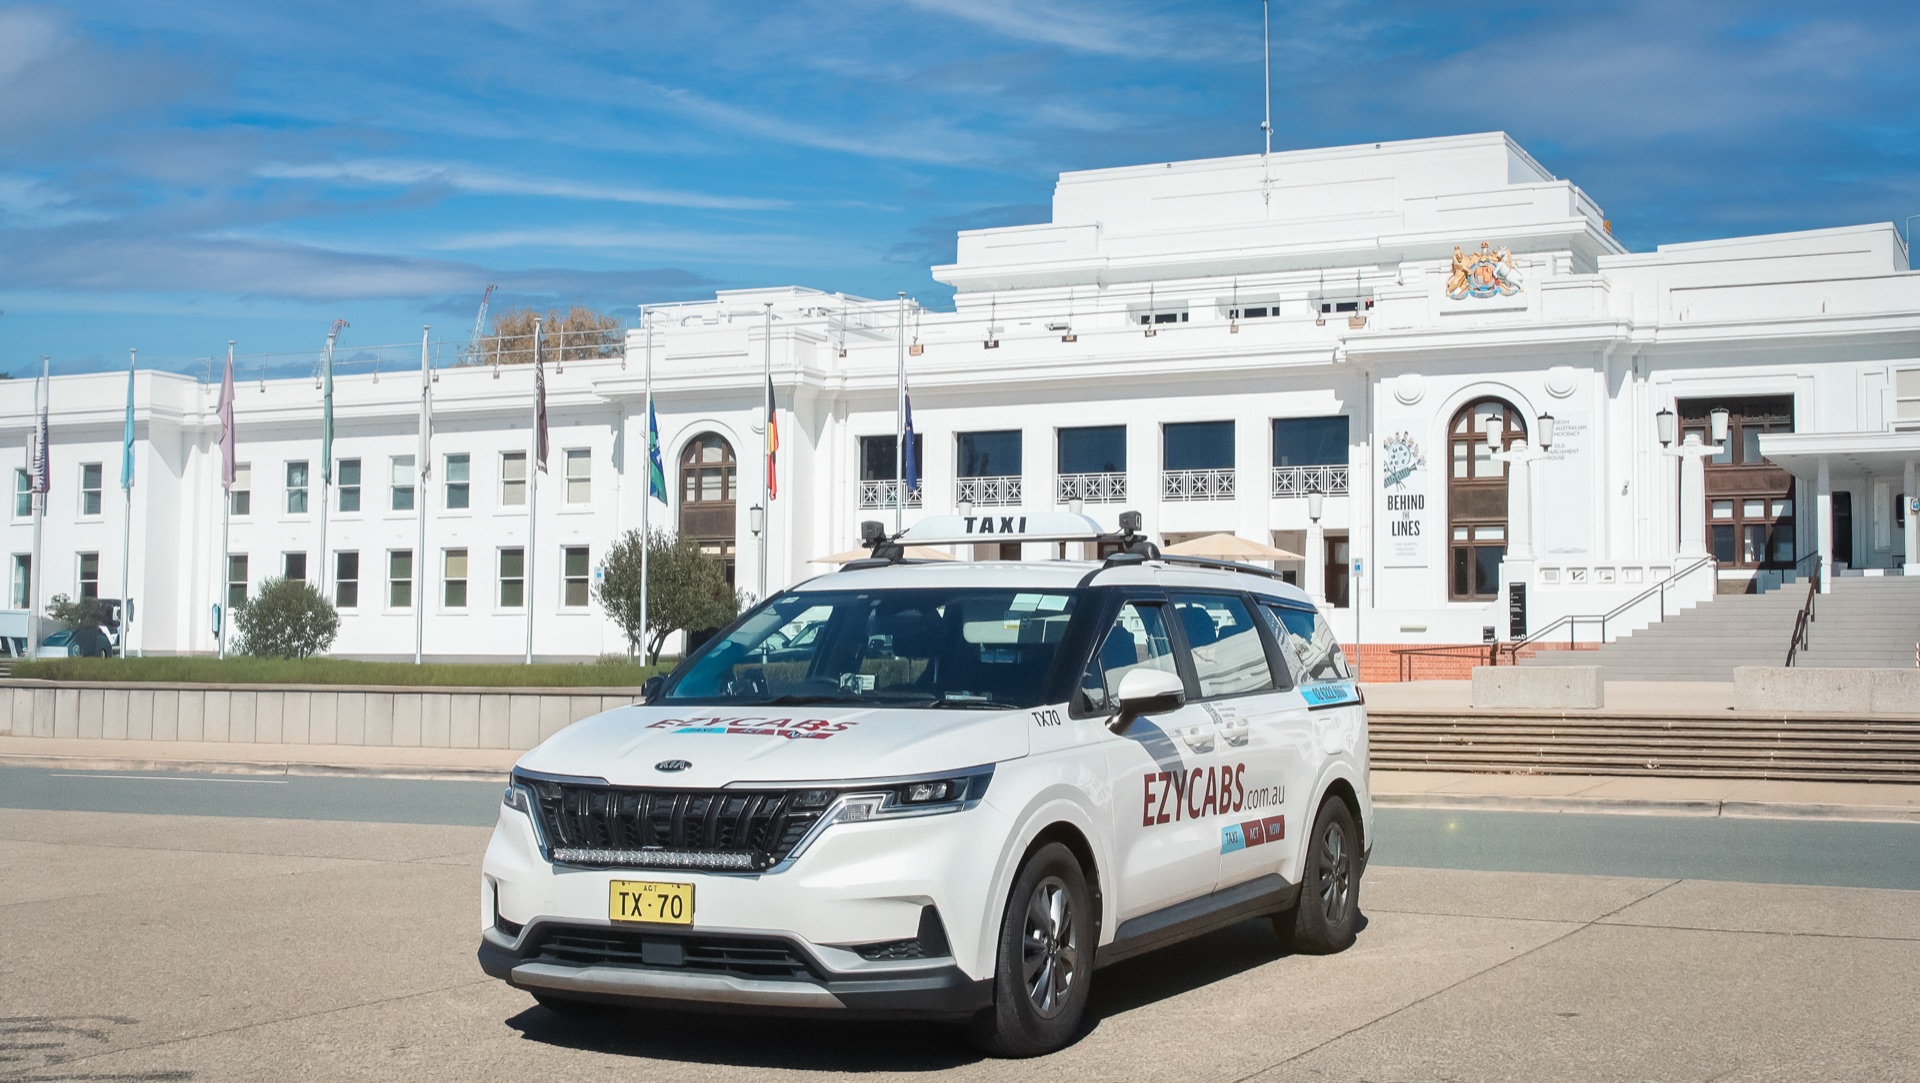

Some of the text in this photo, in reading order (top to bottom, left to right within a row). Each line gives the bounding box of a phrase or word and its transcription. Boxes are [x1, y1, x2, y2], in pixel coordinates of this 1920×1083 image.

[1387, 494, 1425, 511] BEHIND
[1402, 511, 1410, 520] THE
[964, 516, 1028, 534] TAXI
[1391, 520, 1421, 537] LINES
[644, 717, 860, 732] EZYCABS
[1032, 711, 1062, 727] TX70
[658, 759, 686, 770] KIA
[1225, 822, 1281, 845] TAXI ACT NSW
[643, 884, 658, 892] ACT
